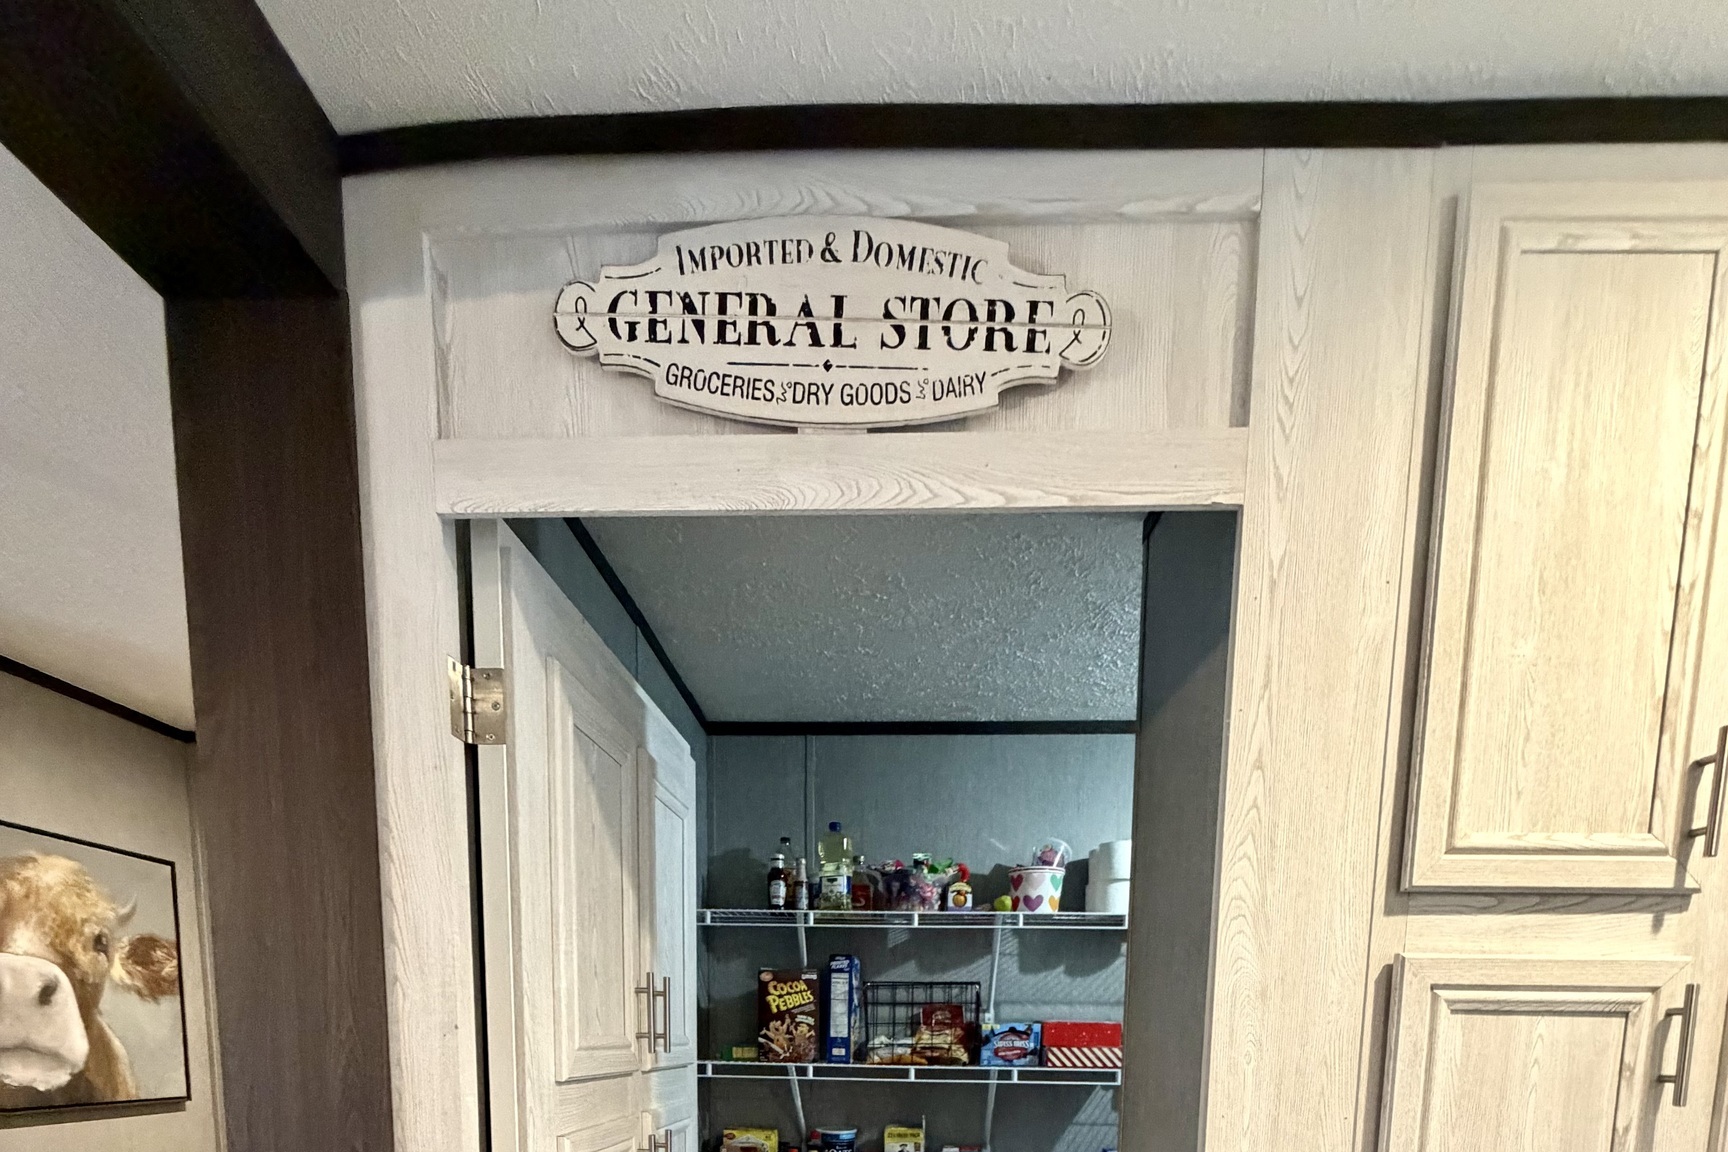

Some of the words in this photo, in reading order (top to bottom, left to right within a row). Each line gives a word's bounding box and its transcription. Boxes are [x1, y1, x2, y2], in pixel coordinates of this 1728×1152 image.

[675, 239, 814, 276] IMPORTED
[820, 231, 843, 263] &
[852, 229, 988, 285] DOMESTIC
[607, 289, 857, 349] GENERAL
[880, 296, 1054, 354] STORE
[665, 362, 775, 402] GROCERIES
[792, 381, 834, 406] DRY
[840, 381, 911, 406] GOODS
[932, 371, 986, 402] DAIRY
[765, 990, 814, 1014] PEBBLES
[767, 980, 808, 995] COCOA
